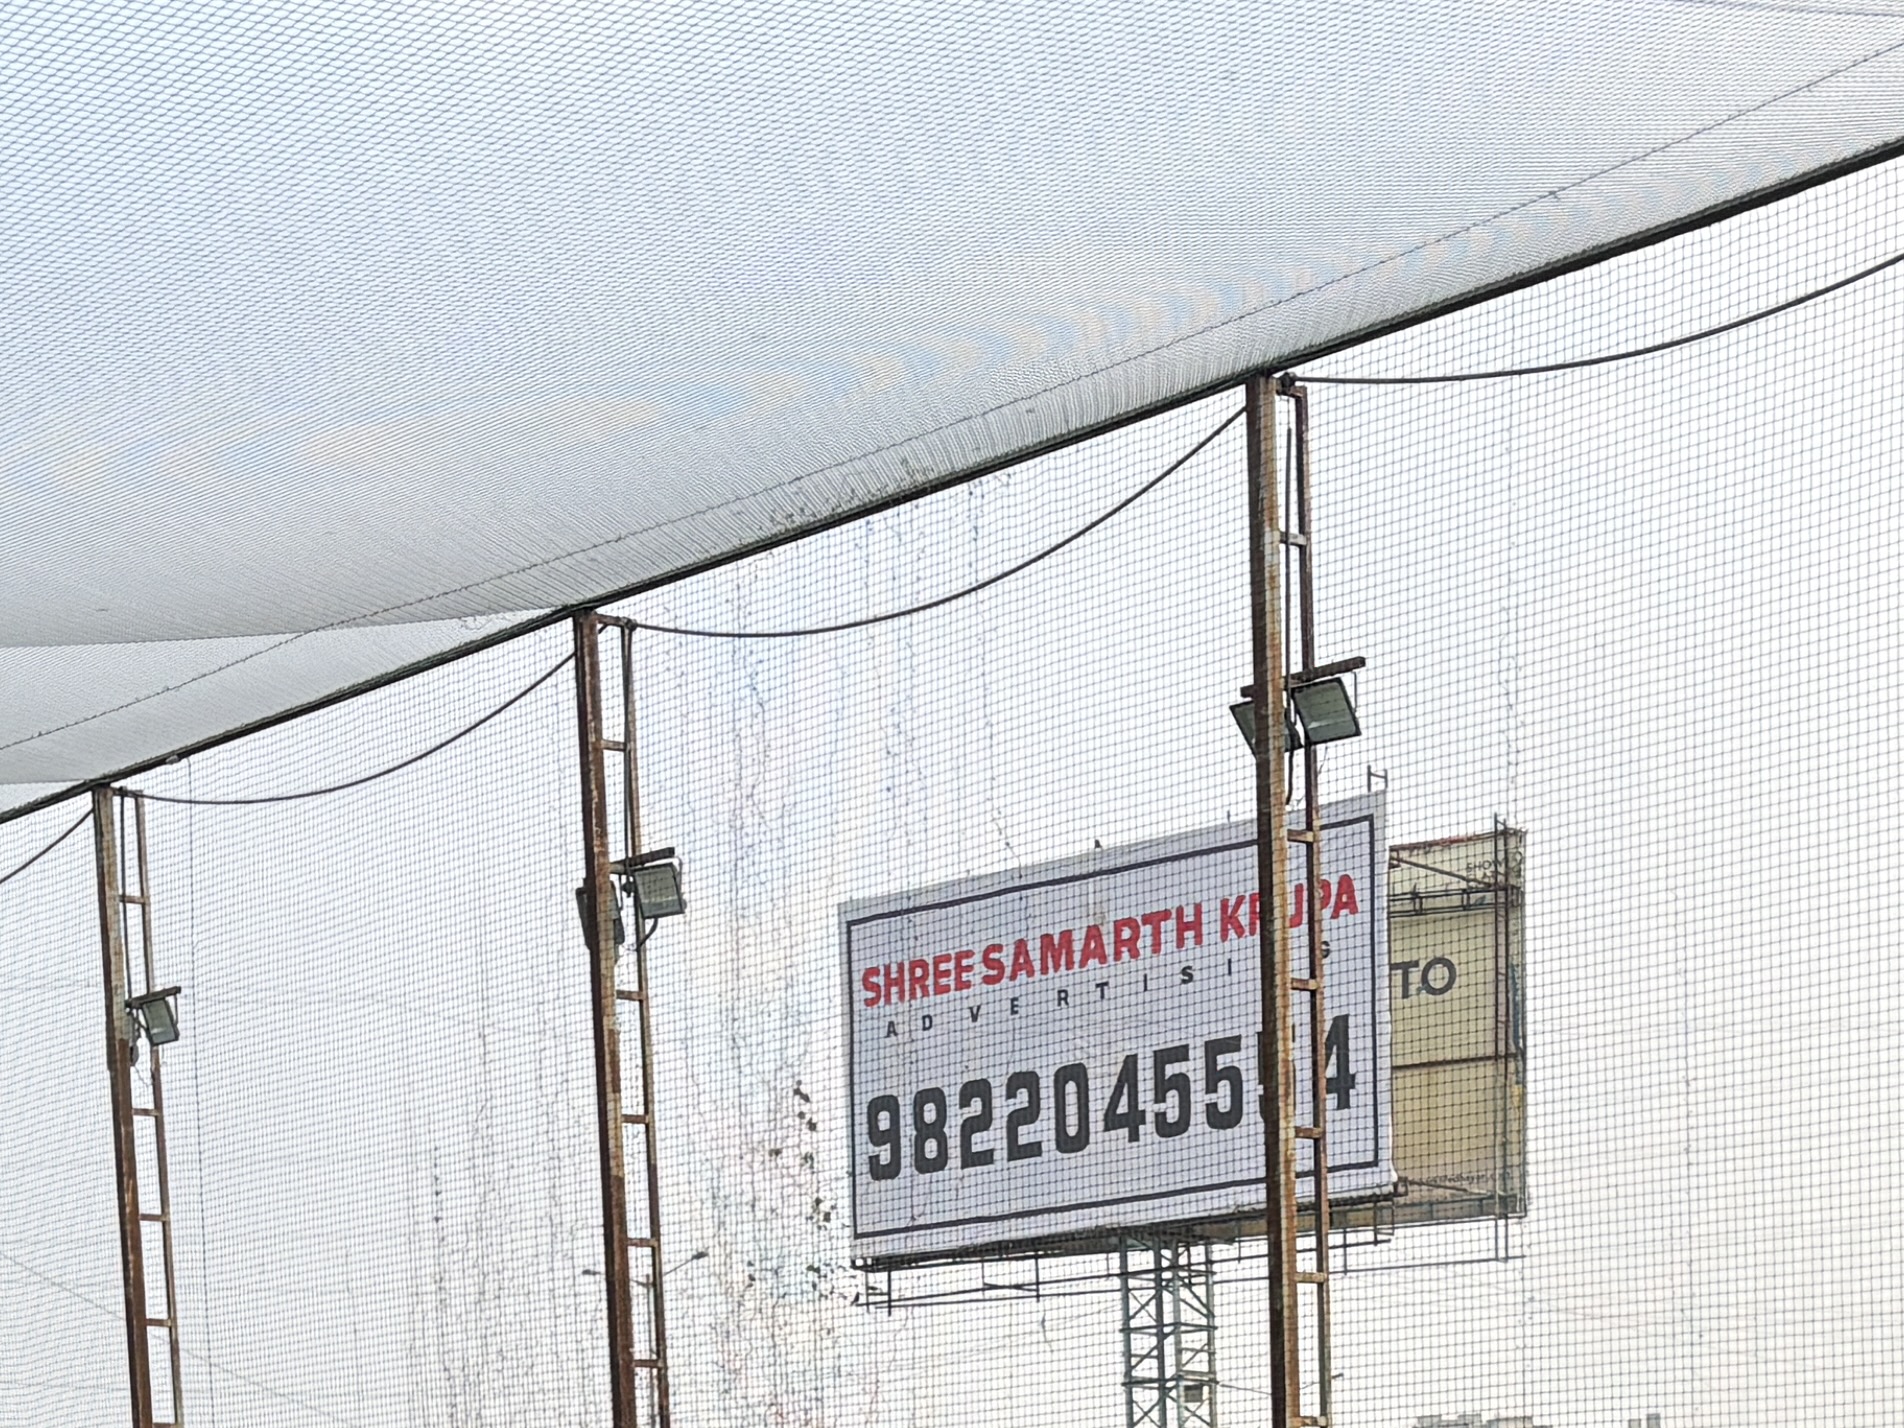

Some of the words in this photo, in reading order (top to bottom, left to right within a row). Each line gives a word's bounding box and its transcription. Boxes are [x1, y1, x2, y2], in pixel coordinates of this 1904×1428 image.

[861, 944, 974, 1008] SHREE
[981, 905, 1204, 982] SAMARTH
[886, 941, 1331, 1038] ADVERTISIG
[866, 1013, 1357, 1181] 982204554
